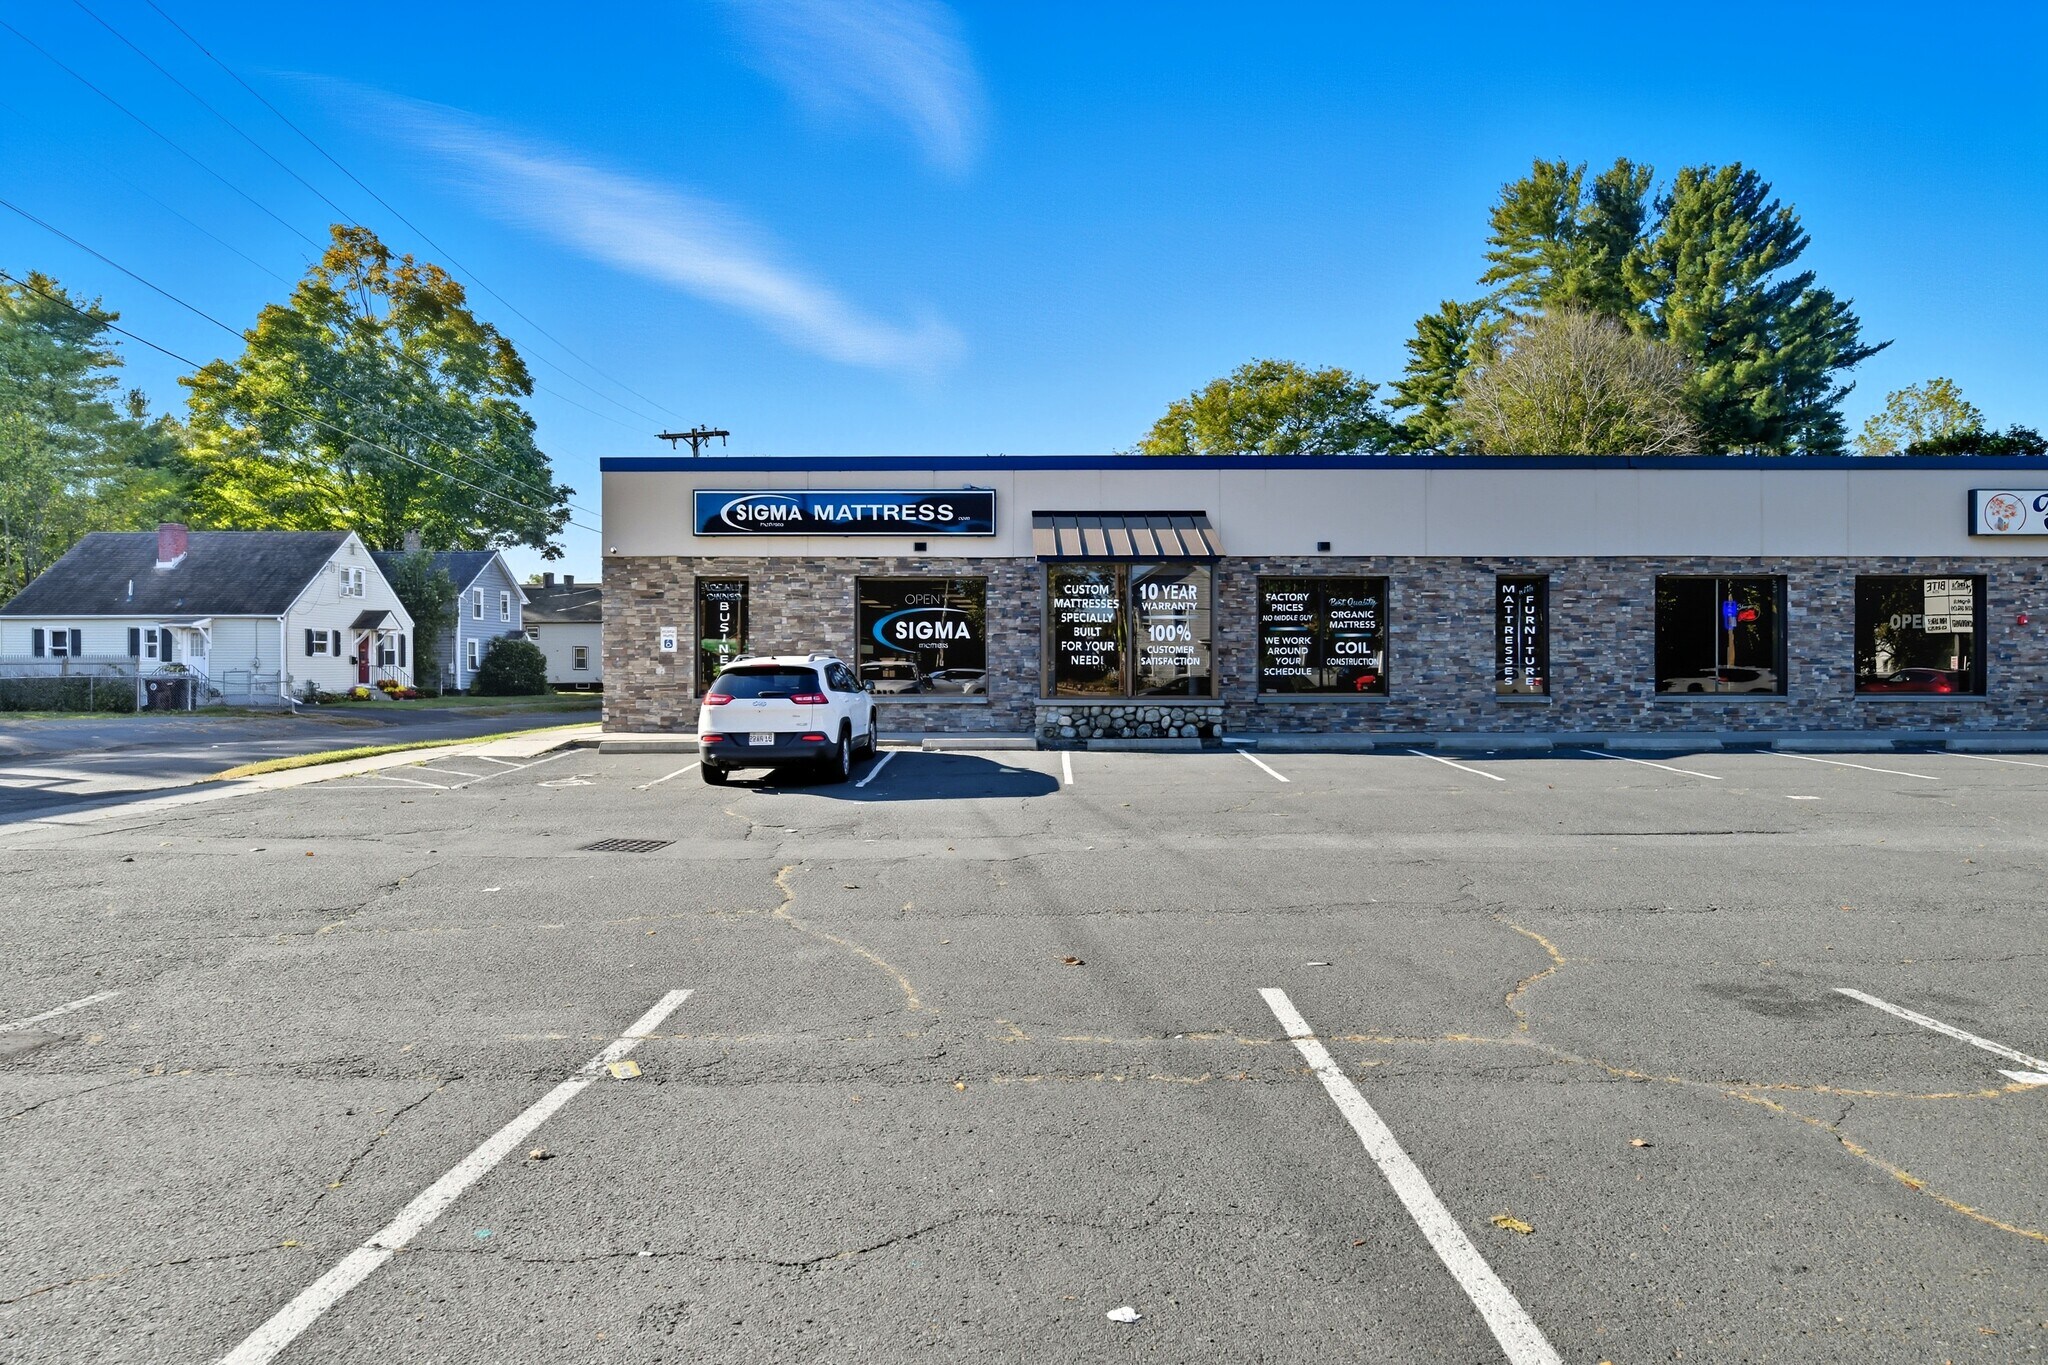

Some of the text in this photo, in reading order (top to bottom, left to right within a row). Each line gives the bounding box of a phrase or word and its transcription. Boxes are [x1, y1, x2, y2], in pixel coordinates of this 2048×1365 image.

[736, 503, 803, 521] SIGMA
[814, 504, 954, 521] MATTRESS
[1064, 584, 1109, 595] CUSTOM
[1140, 583, 1198, 600] 10 YEAR
[904, 593, 940, 605] OPEN
[1265, 593, 1310, 602] FACTORY
[1053, 598, 1120, 609] MATTRESSES
[1141, 602, 1198, 611] WARRANTY
[1271, 603, 1304, 612] PRICES
[1060, 612, 1114, 623] SPECIALLY
[1262, 614, 1313, 622] NO MIDDLE GUY
[1330, 610, 1374, 619] ORGANIC
[1329, 620, 1376, 629] MATTRESS
[895, 621, 971, 640] SIGMA
[1073, 626, 1102, 637] BUILT
[1148, 624, 1192, 642] 100%
[1502, 584, 1516, 686] MATTRESSES
[1264, 636, 1312, 645] WE WORK
[1524, 595, 1536, 686] FURNITURE
[1061, 641, 1115, 651] FOR YOUR
[1147, 645, 1195, 654] CUSTOMER
[1334, 641, 1371, 655] COIL
[1267, 647, 1309, 655] AROUND
[1140, 657, 1200, 666] SATISFACTION
[1275, 657, 1301, 665] YOUR
[1326, 657, 1379, 666] CONSTRUCTION
[1263, 667, 1313, 676] SCHEDULE
